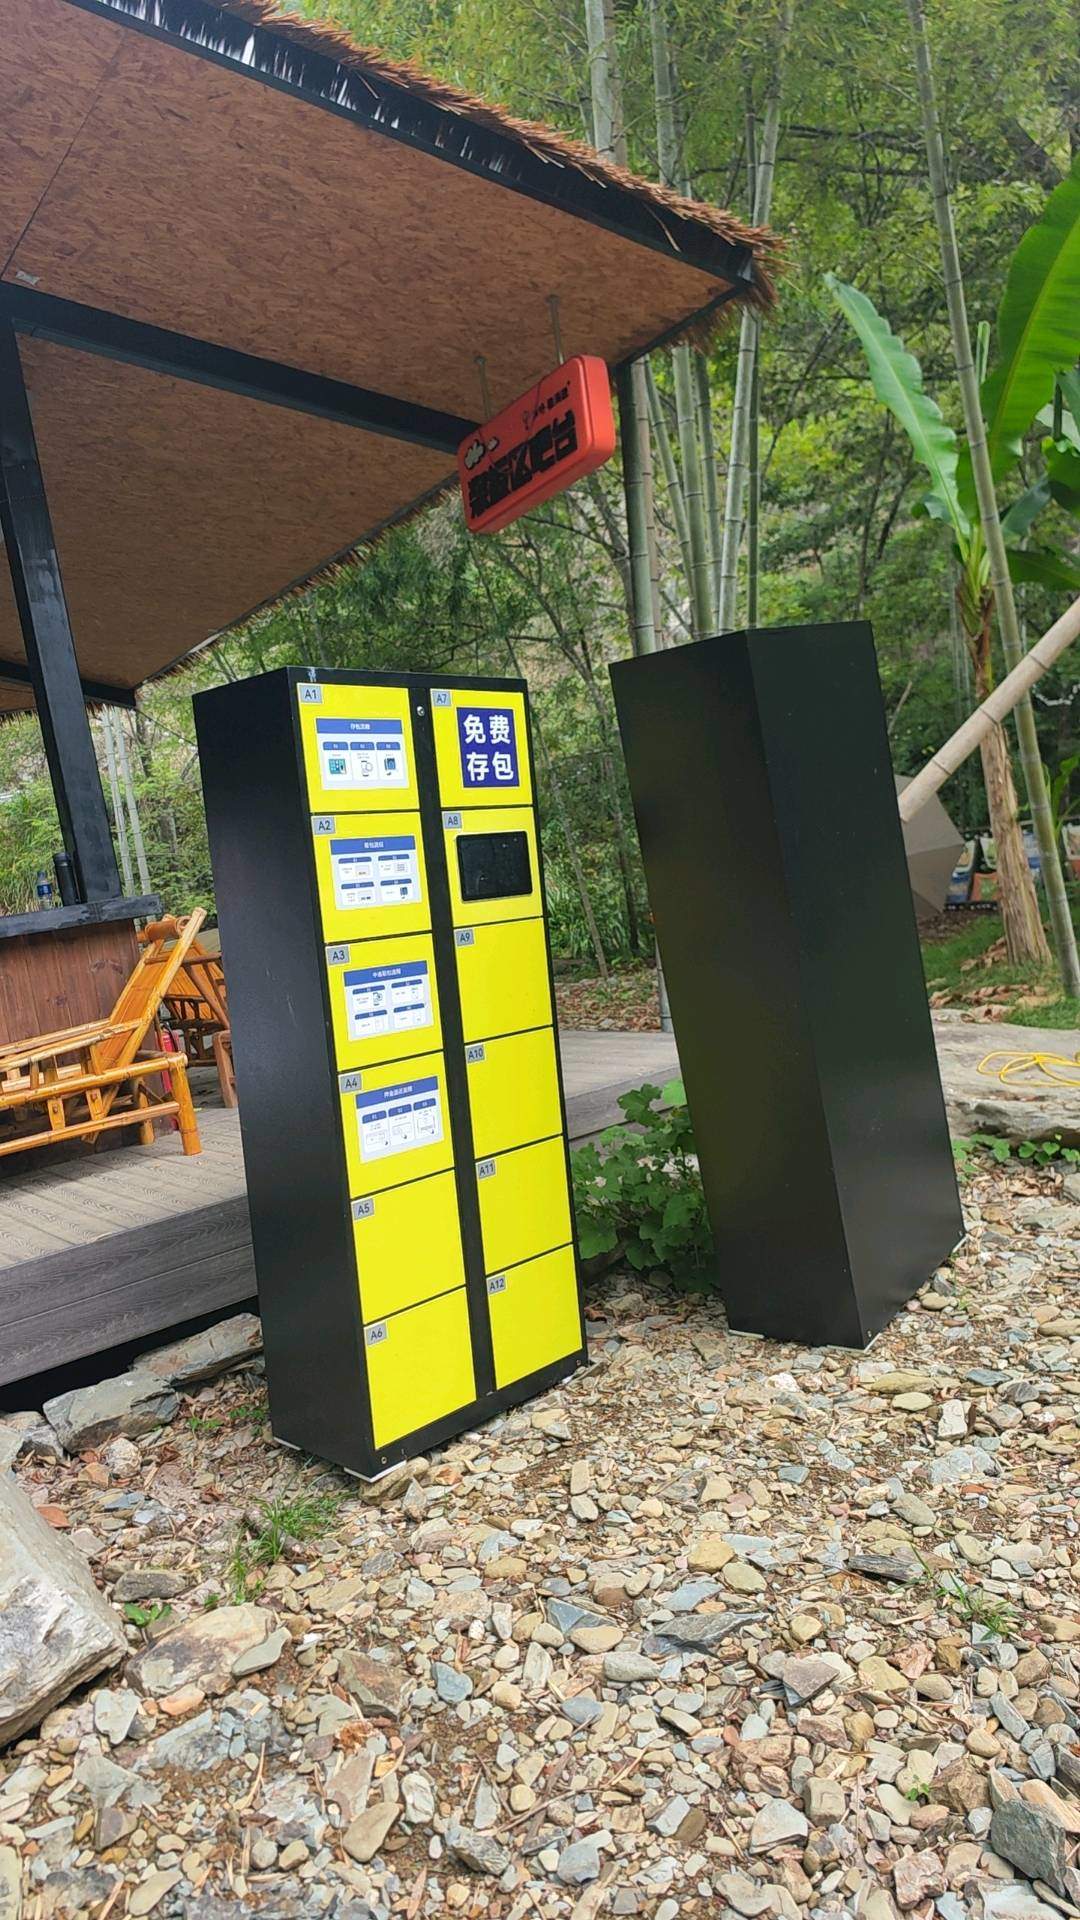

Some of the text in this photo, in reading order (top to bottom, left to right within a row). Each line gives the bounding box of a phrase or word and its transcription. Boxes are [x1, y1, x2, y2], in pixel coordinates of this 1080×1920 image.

[305, 690, 318, 699] A1
[436, 693, 447, 704] A7
[463, 714, 511, 744] 免费
[466, 751, 514, 781] 存包
[318, 820, 331, 831] A2
[447, 815, 459, 826] A8
[459, 932, 471, 944] A9
[332, 950, 345, 961] A3
[468, 1046, 484, 1060] A10
[345, 1077, 358, 1089] A4
[478, 1162, 495, 1176] A11
[358, 1202, 371, 1215] A5
[489, 1277, 506, 1292] A12
[370, 1326, 383, 1340] A6
